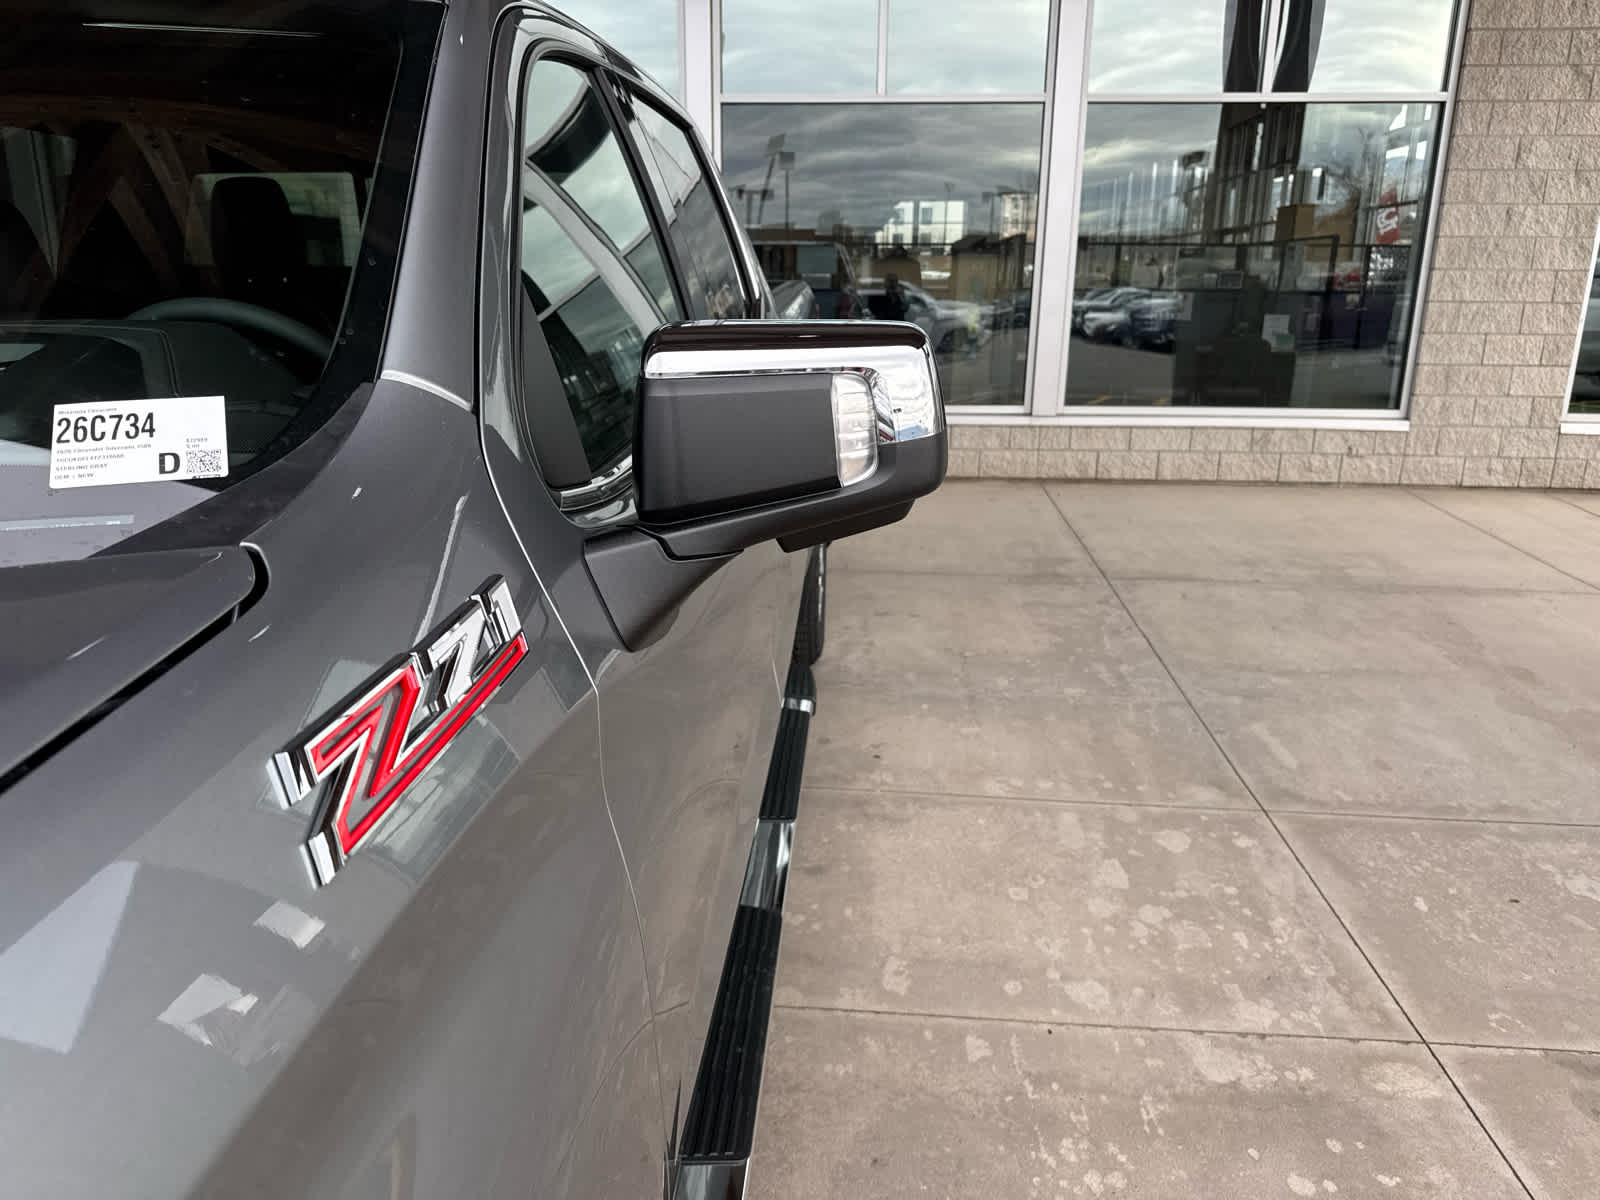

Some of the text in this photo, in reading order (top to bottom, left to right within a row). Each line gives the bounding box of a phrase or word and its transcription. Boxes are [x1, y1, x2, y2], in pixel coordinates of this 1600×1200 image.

[56, 411, 156, 444] 26C734
[158, 452, 181, 475] D
[266, 574, 529, 890] Z71
